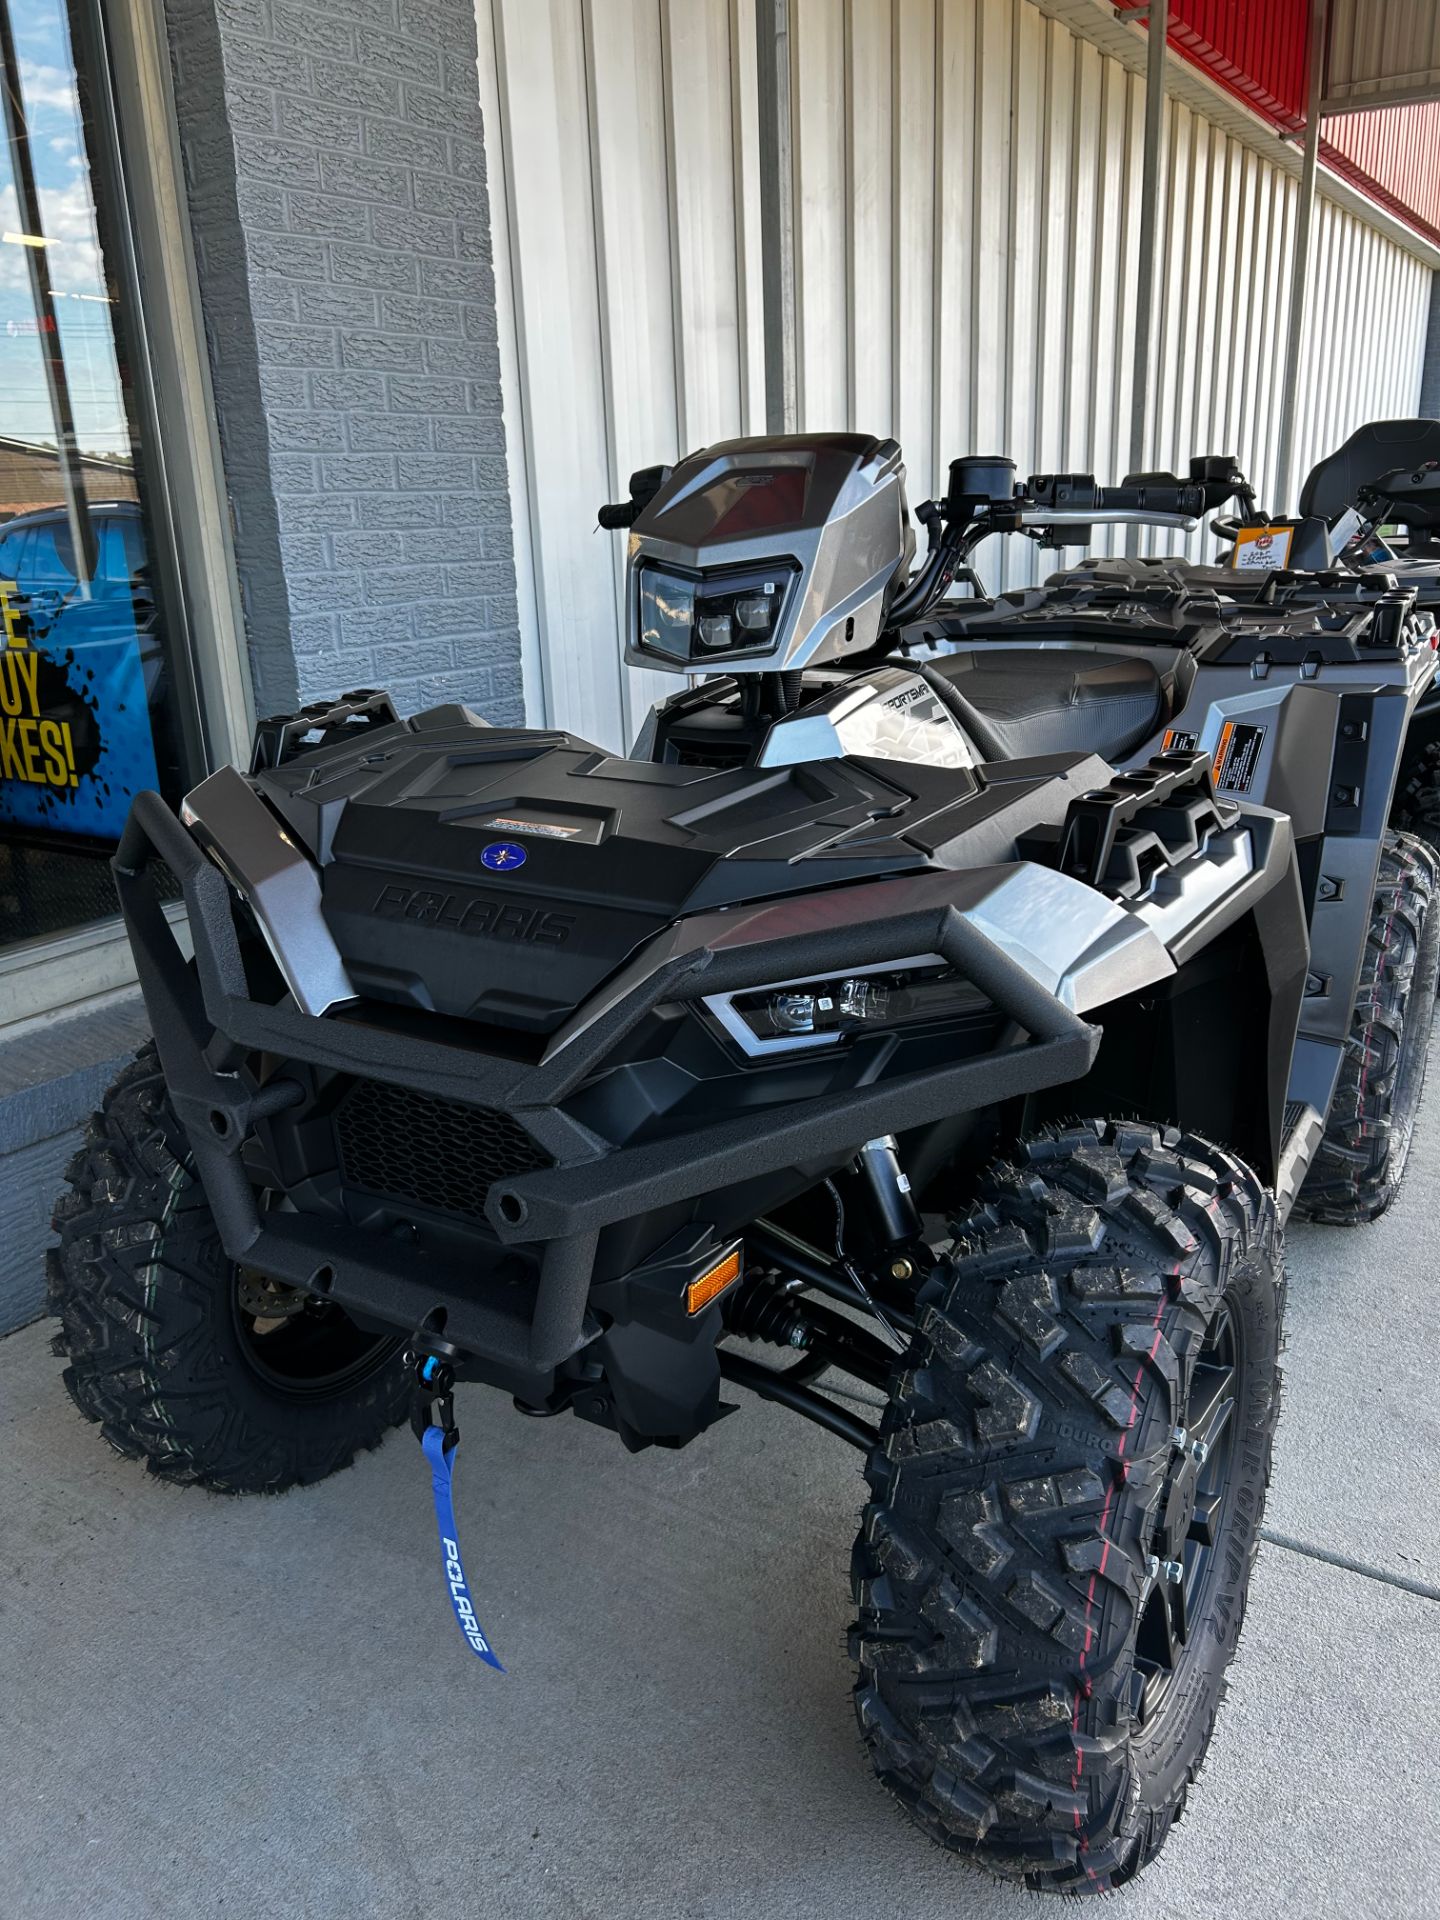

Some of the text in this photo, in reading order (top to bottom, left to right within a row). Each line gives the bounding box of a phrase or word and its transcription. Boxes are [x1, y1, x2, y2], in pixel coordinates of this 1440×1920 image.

[0, 717, 79, 787] KES!
[1216, 739, 1227, 765] WARNING
[371, 884, 576, 943] POLARIS
[1058, 1423, 1114, 1453] DURO
[443, 1537, 489, 1652] POLARIS
